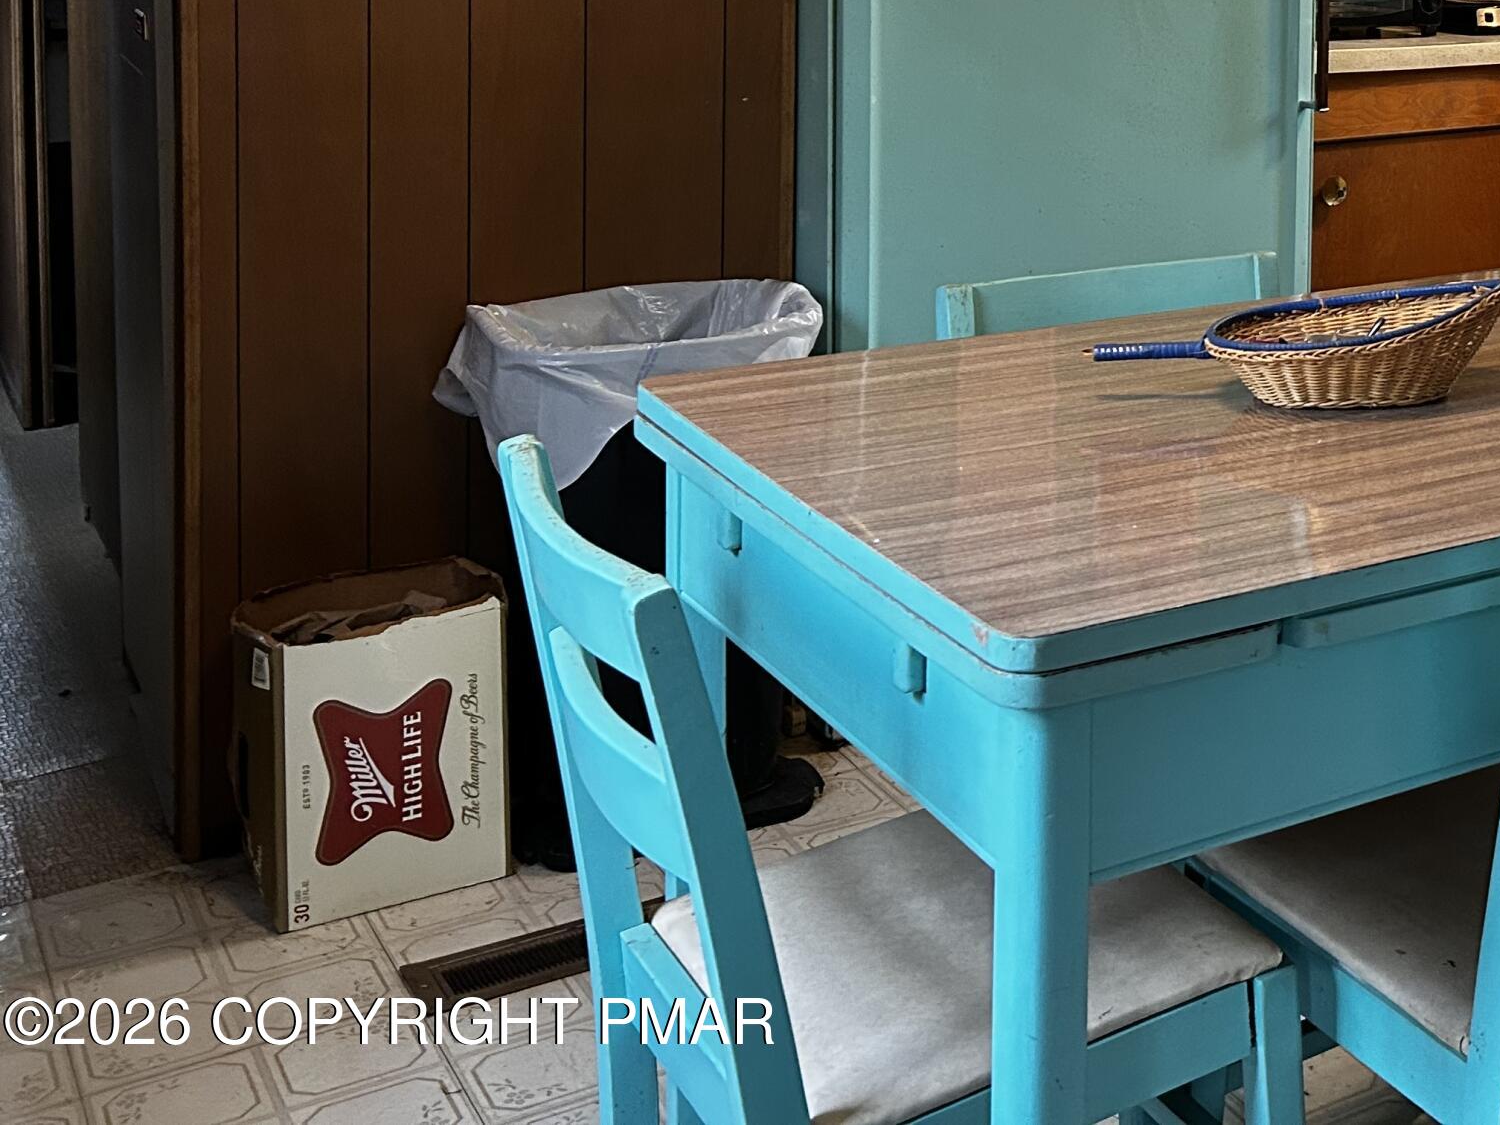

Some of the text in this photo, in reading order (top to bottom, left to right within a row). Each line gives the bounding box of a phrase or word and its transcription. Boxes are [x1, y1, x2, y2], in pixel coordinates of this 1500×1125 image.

[459, 673, 479, 713] Beers
[343, 735, 393, 823] Miller
[401, 711, 423, 822] HIGH LIFE
[460, 725, 487, 799] Champagne
[461, 800, 480, 829] The
[294, 904, 310, 924] 30
